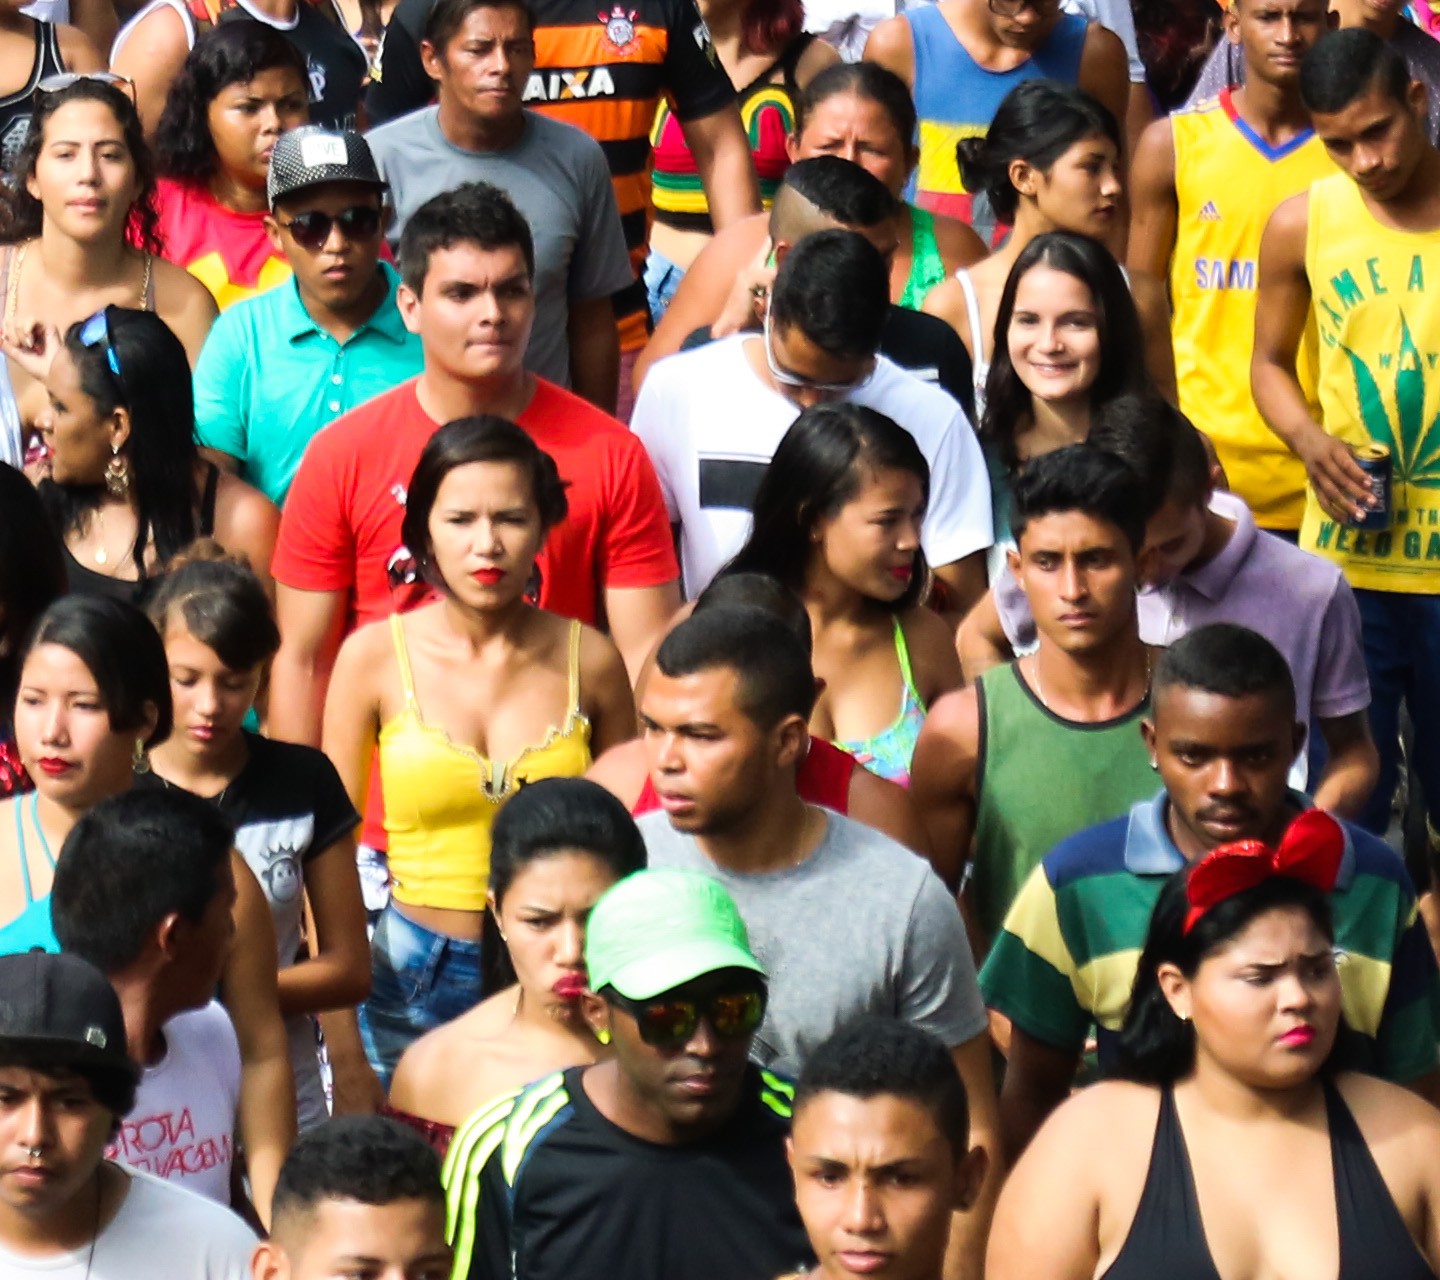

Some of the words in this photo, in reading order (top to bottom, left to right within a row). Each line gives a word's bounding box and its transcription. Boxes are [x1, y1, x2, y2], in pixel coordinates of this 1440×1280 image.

[521, 68, 616, 102] AIXA
[1193, 257, 1256, 291] SAM
[1407, 254, 1426, 293] A
[1378, 346, 1439, 371] WAY
[1314, 519, 1396, 560] WEED
